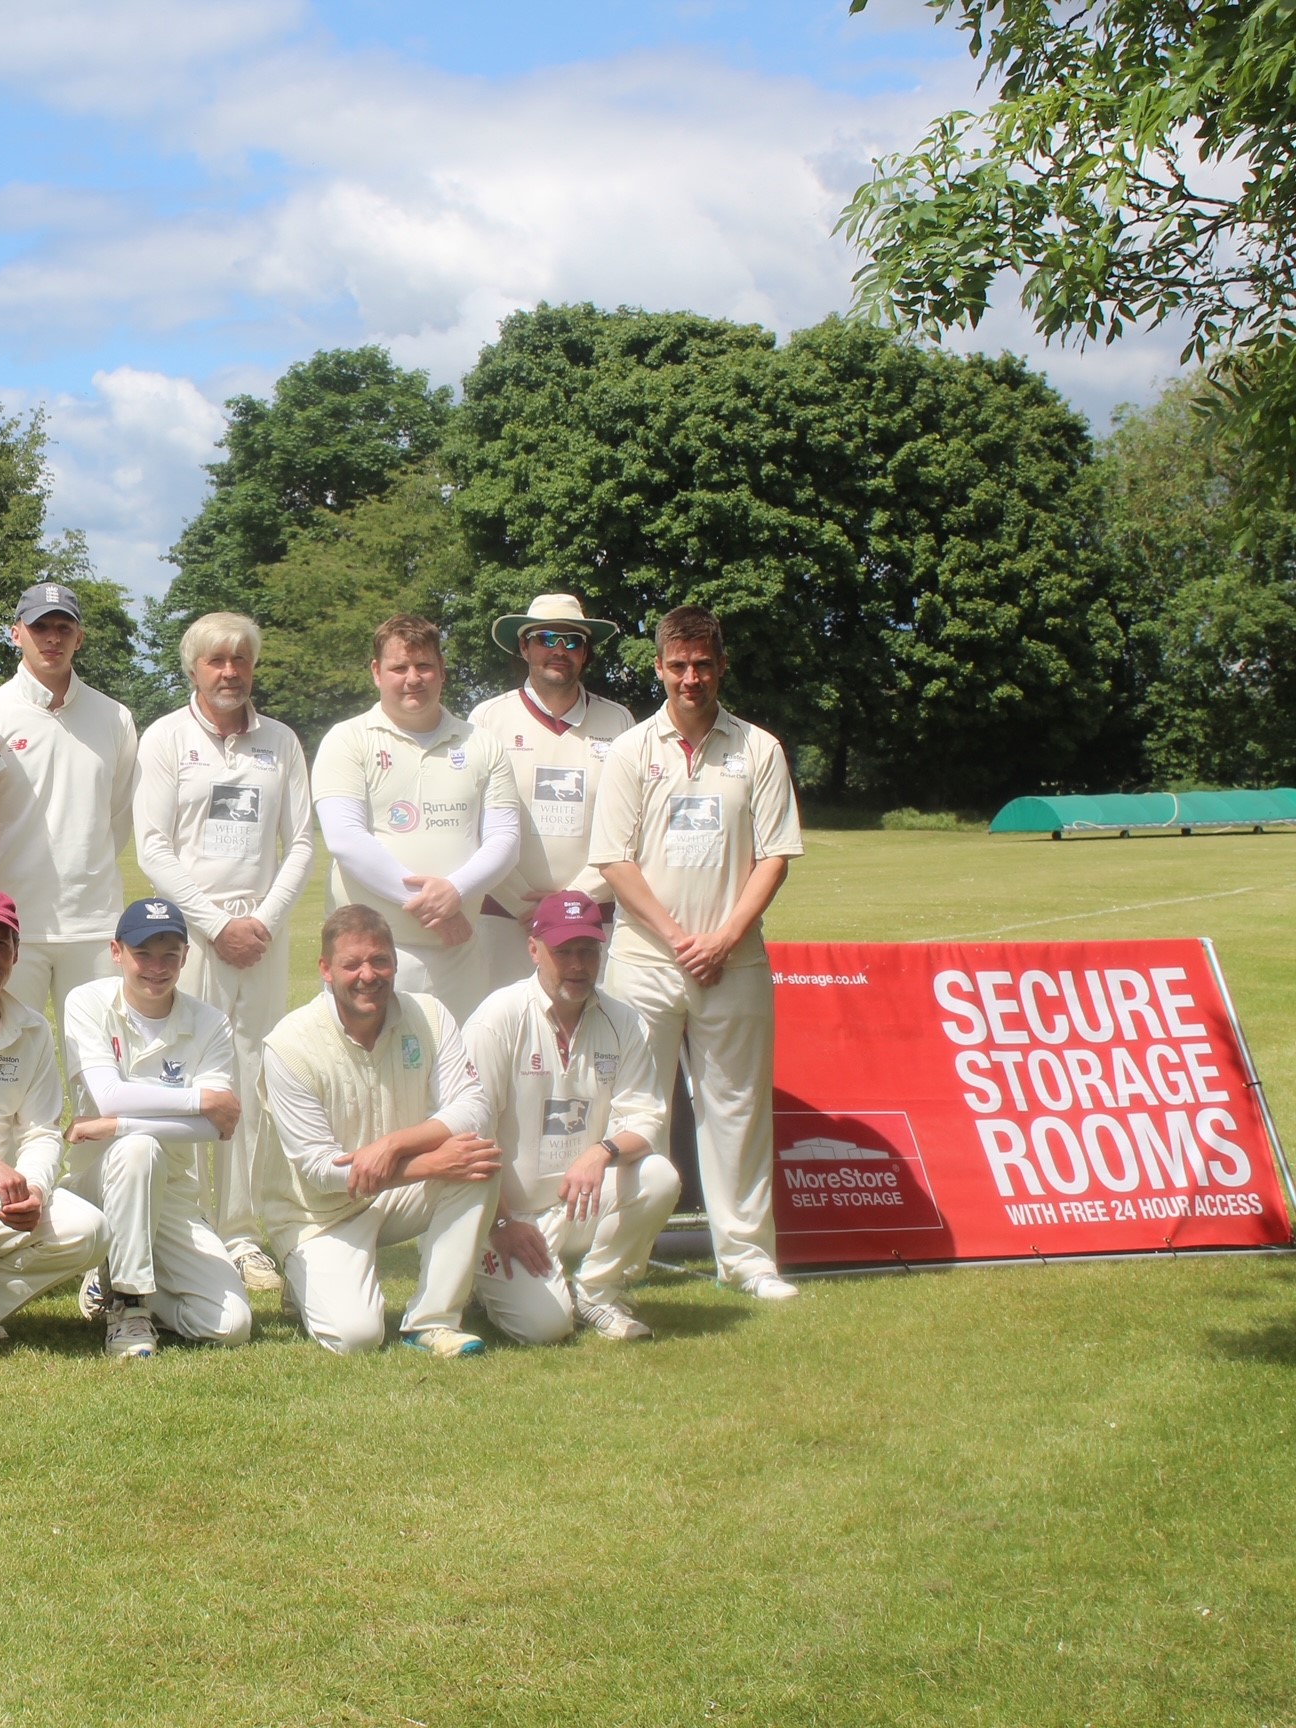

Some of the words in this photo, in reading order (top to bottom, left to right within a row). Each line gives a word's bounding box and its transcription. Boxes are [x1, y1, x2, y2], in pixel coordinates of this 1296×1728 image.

[540, 804, 576, 814] WHITE
[540, 814, 576, 824] HORSE
[215, 824, 251, 834] WHITE
[215, 834, 251, 846] HORSE
[933, 967, 1207, 1046] SECURE
[954, 1043, 1231, 1114] STORAGE
[549, 1136, 583, 1148] WHITE
[975, 1108, 1252, 1197] ROOMS
[791, 1193, 829, 1208] SELF
[832, 1192, 904, 1206] STORAGE
[1004, 1203, 1059, 1226] WITH
[1059, 1200, 1110, 1224] FREE
[1110, 1200, 1137, 1221] 24
[1137, 1195, 1193, 1220] HOUR
[1194, 1192, 1264, 1216] ACCESS
